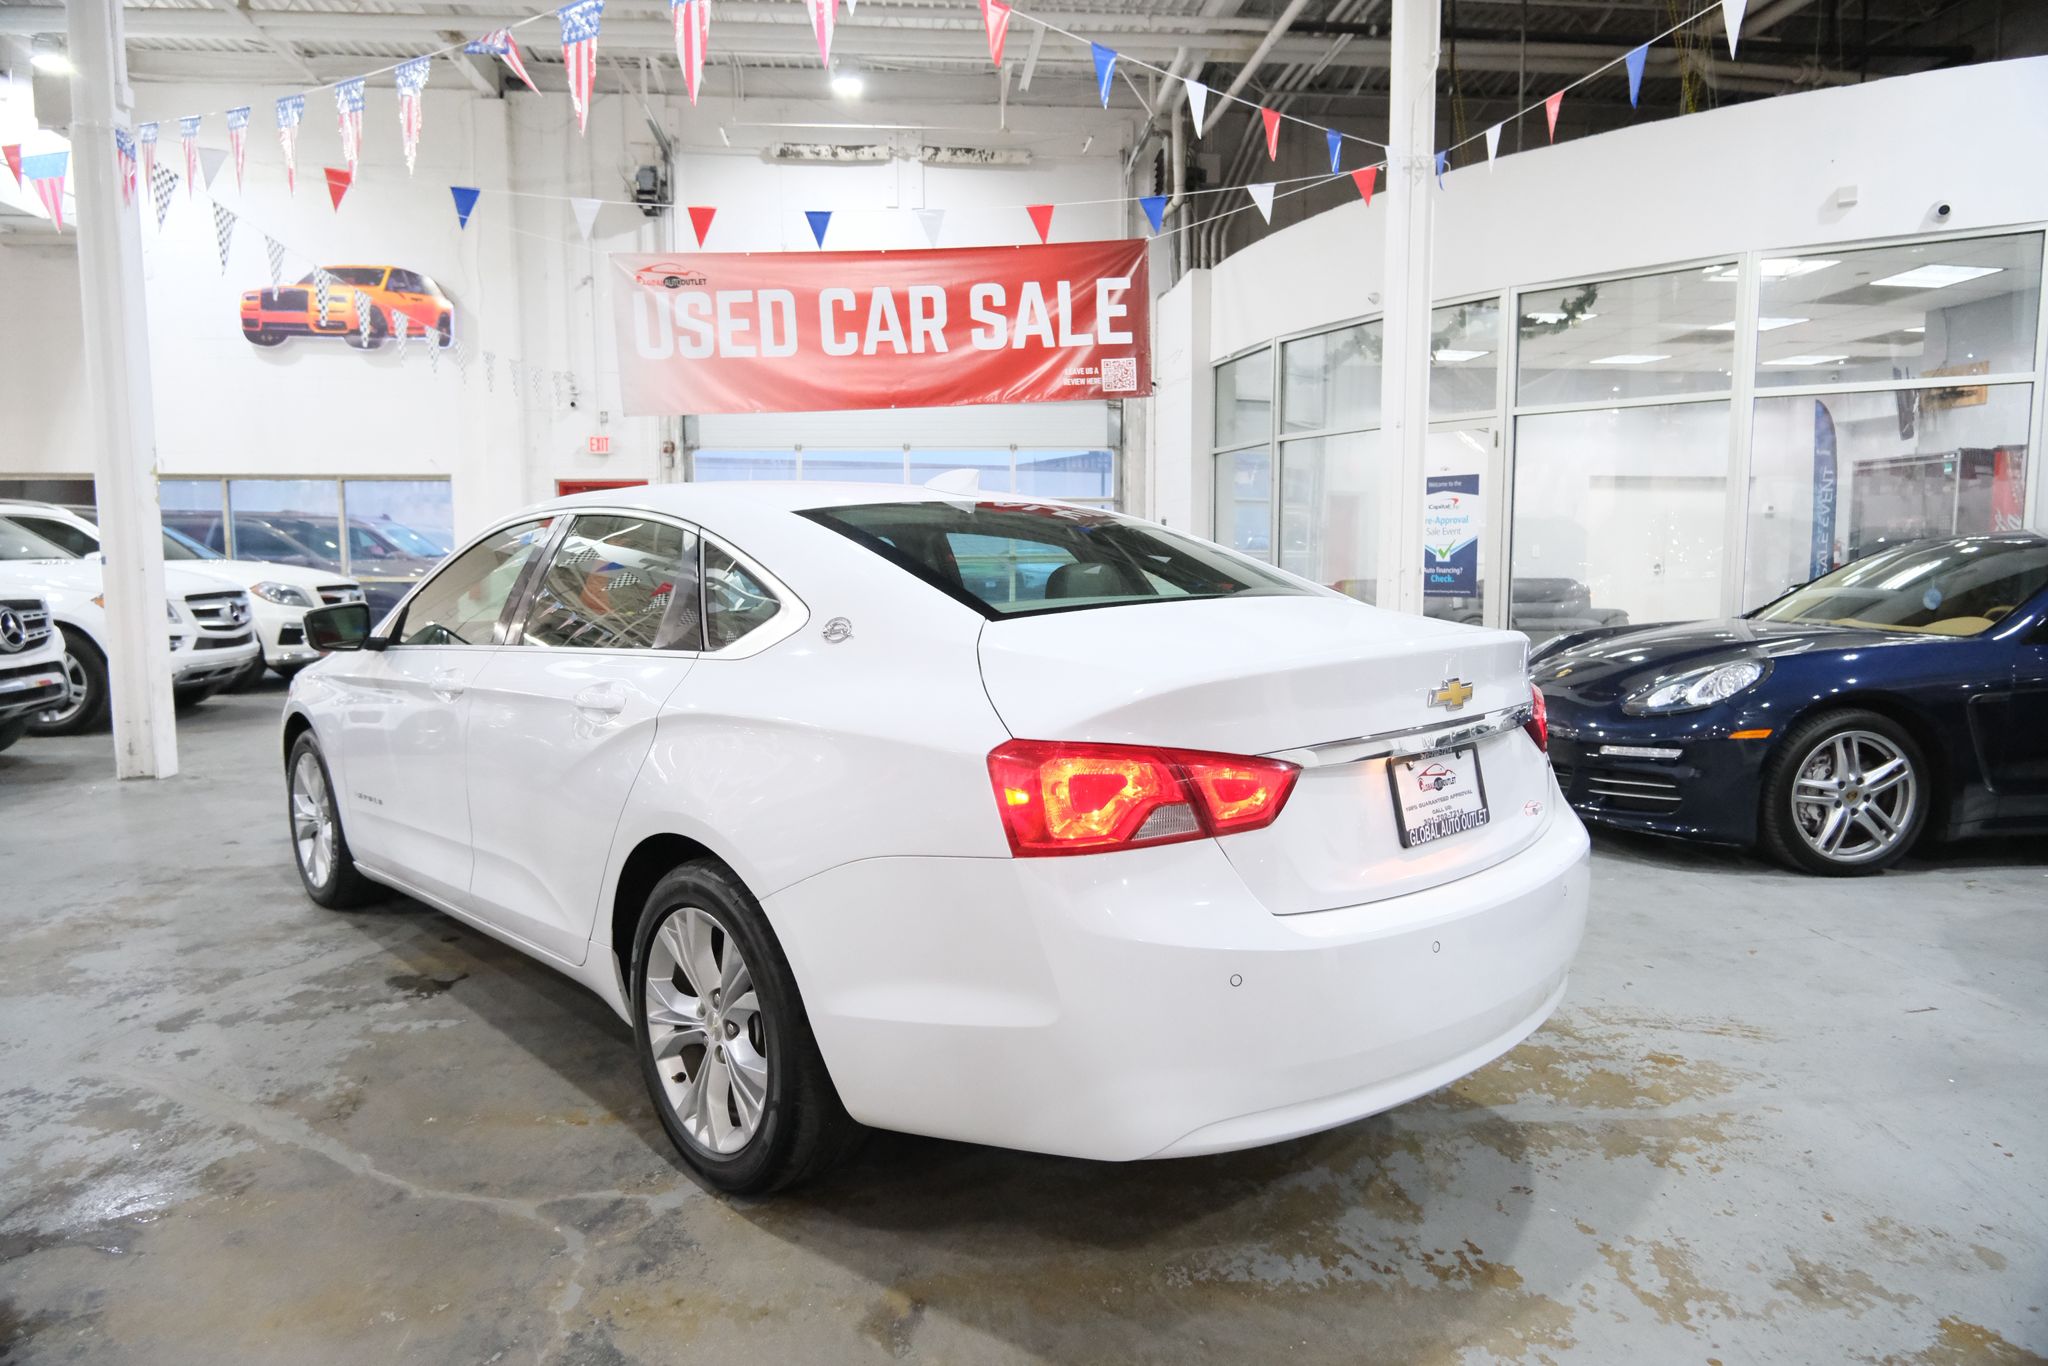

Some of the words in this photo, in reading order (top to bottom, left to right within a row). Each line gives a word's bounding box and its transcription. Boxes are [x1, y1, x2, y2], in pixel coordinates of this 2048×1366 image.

[633, 288, 797, 361] USED
[818, 283, 948, 357] CAR
[969, 276, 1134, 352] SALE
[589, 436, 609, 452] EXIT
[1822, 465, 1834, 528] EVENT
[1425, 514, 1469, 526] re-Approval
[1426, 527, 1441, 536] Sale
[1442, 527, 1462, 536] Event
[1435, 566, 1464, 575] financing?
[1430, 574, 1455, 583] Check.
[1409, 826, 1441, 847] GLOBAL
[1441, 817, 1461, 836] AUTO
[1461, 808, 1488, 830] OUTLET
